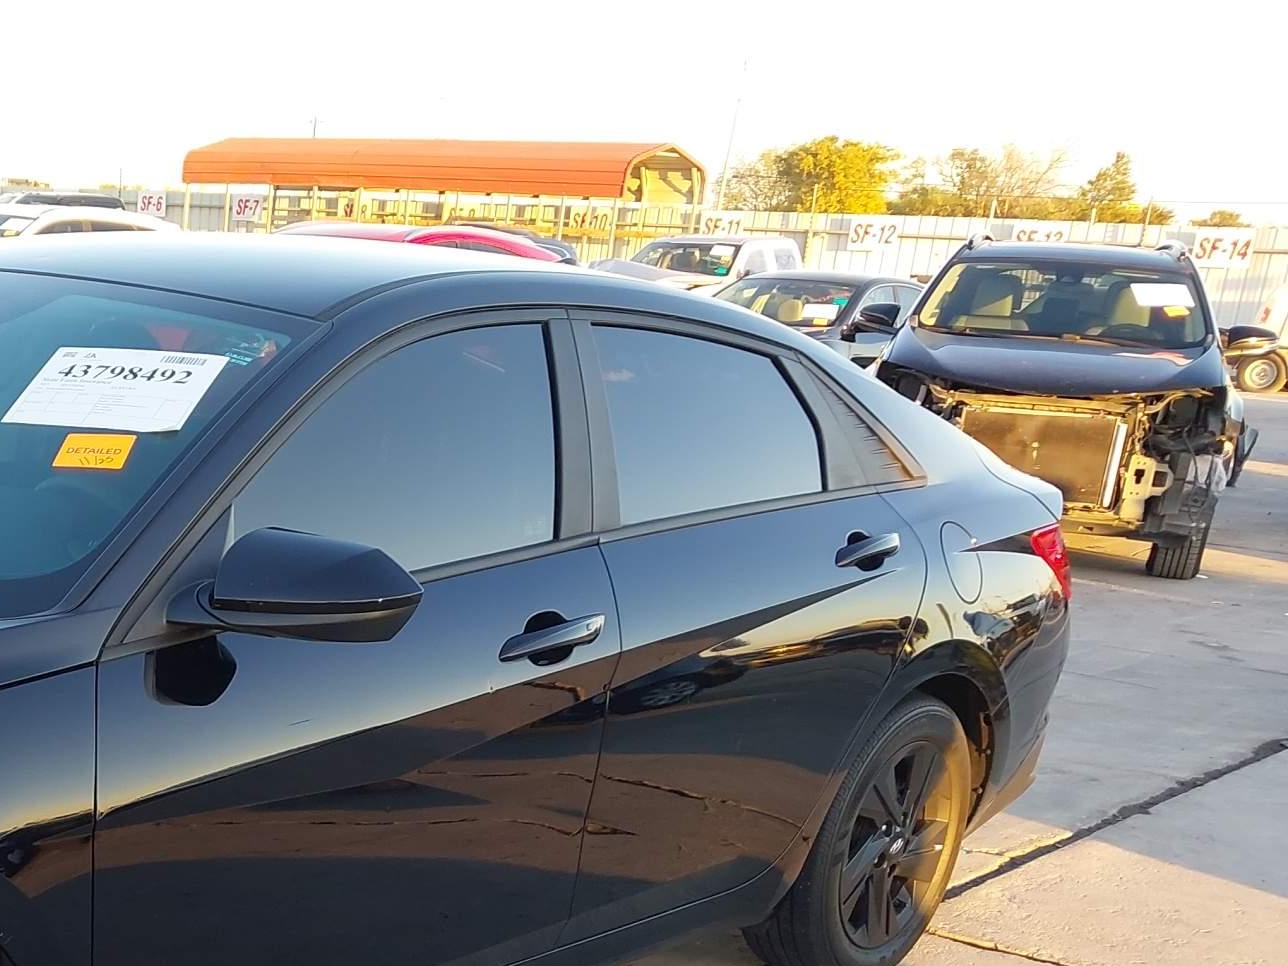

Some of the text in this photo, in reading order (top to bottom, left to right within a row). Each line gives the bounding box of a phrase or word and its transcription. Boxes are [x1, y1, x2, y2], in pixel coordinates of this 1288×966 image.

[140, 195, 163, 212] SF-6
[236, 198, 259, 216] SF-7
[702, 217, 742, 236] SF-11
[850, 223, 898, 244] SF-12
[1195, 237, 1253, 261] SF-14
[57, 363, 193, 385] 43798492
[65, 447, 123, 456] DETAILED
